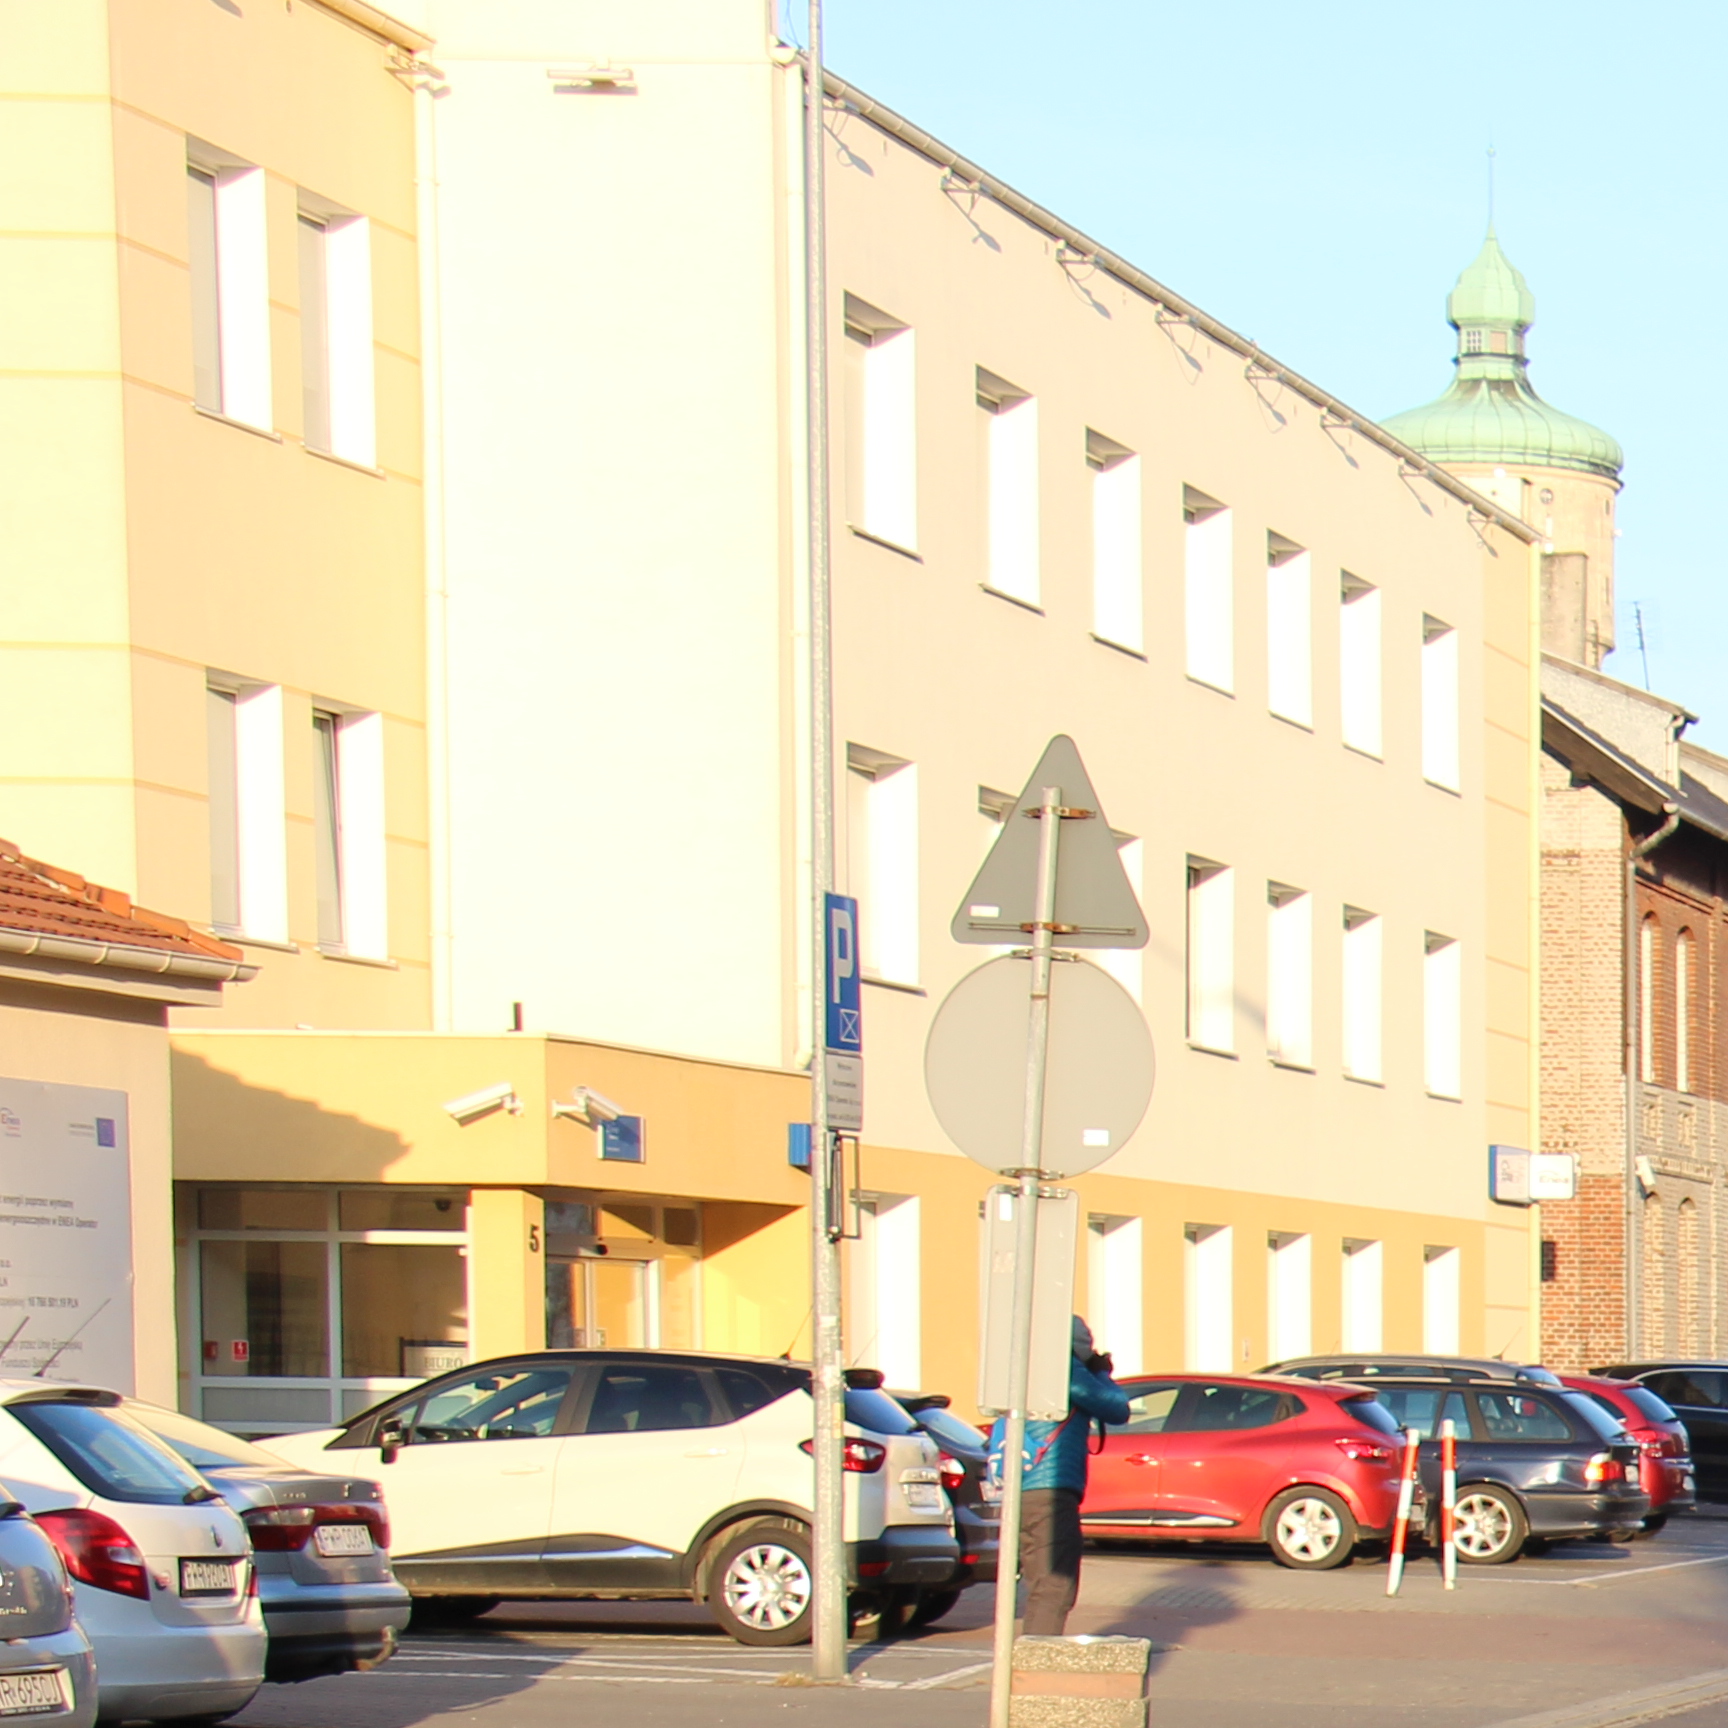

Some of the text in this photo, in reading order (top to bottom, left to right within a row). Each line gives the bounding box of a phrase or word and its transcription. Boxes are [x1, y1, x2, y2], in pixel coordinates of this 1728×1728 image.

[832, 908, 854, 1004] P
[529, 1224, 541, 1253] 5
[424, 1356, 464, 1368] BIURO
[18, 1674, 59, 1705] 695CJ
